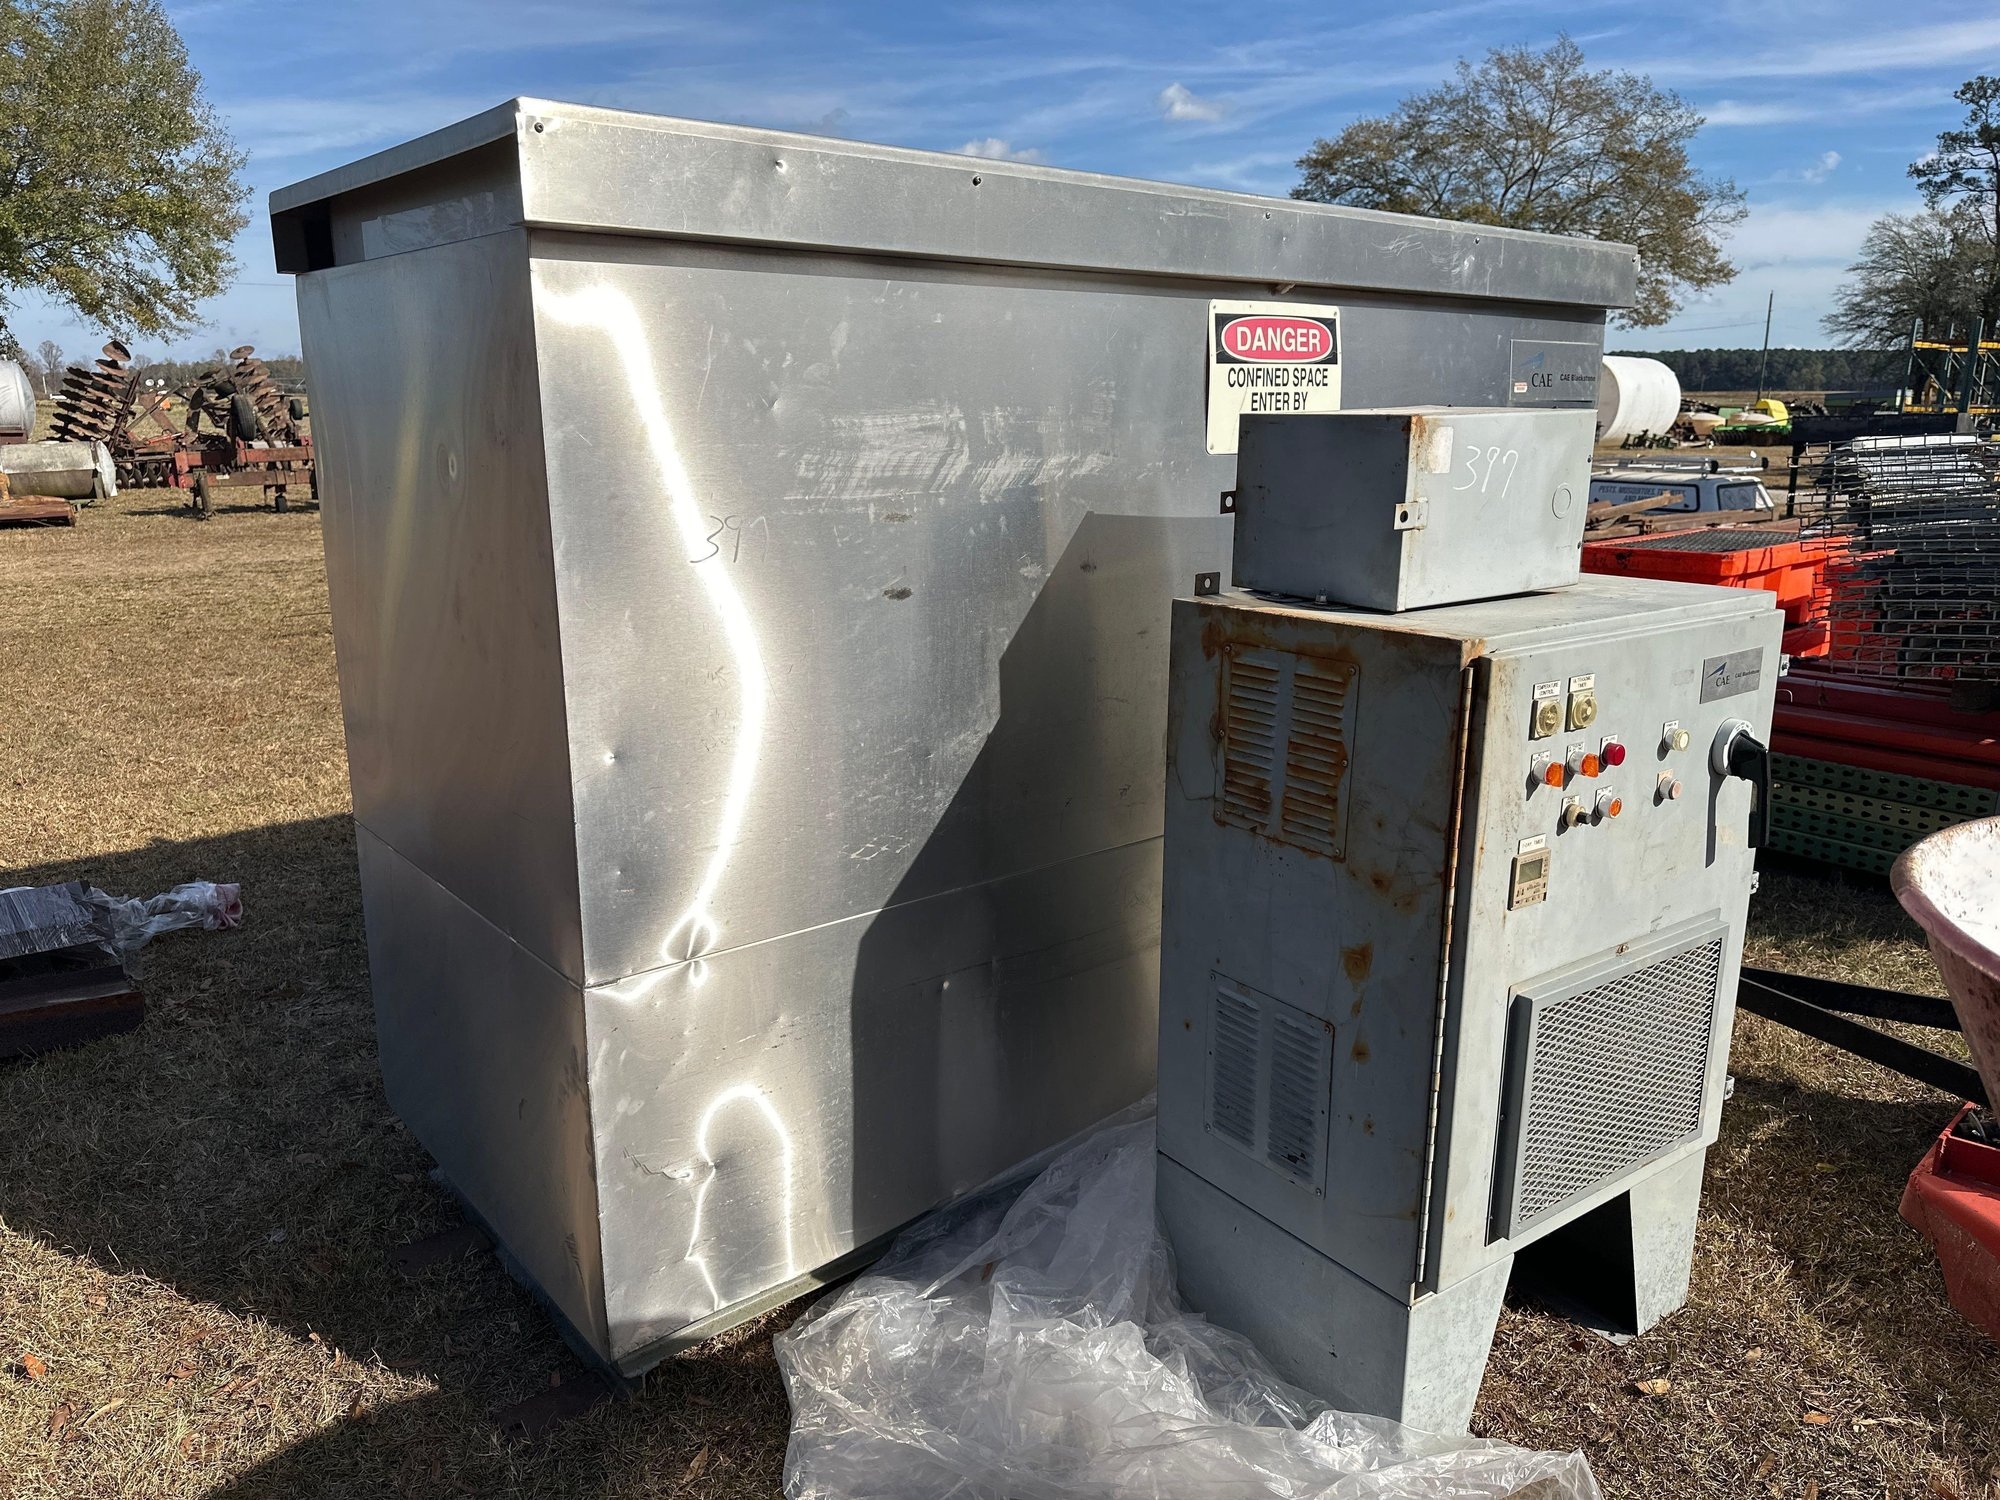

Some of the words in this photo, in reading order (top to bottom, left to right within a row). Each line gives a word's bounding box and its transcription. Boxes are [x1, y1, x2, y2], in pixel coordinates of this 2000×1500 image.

[1236, 326, 1321, 352] DANGER
[1228, 367, 1290, 388] CONFINED
[1292, 367, 1328, 387] SPACE
[1531, 373, 1553, 388] CAE
[1560, 373, 1570, 381] CAE
[1251, 391, 1290, 411] ENTER
[1293, 391, 1308, 411] BY
[1715, 675, 1730, 687] CAE
